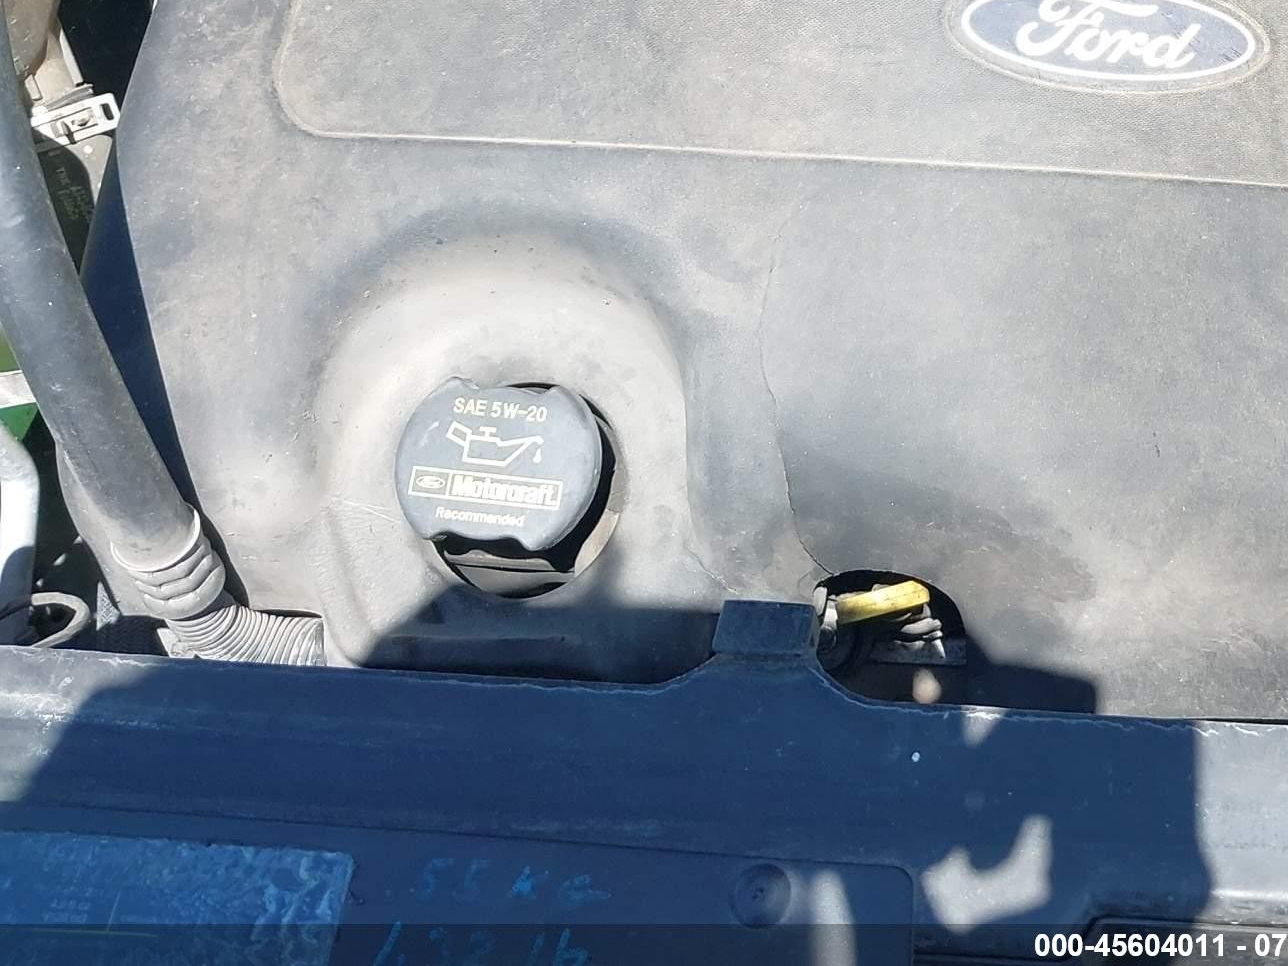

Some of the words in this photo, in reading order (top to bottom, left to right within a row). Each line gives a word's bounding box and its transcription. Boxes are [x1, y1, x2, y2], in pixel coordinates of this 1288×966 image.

[453, 397, 488, 416] SAE
[490, 402, 548, 422] 5W-20
[452, 474, 556, 506] Motorcraft
[435, 507, 526, 527] Recommended
